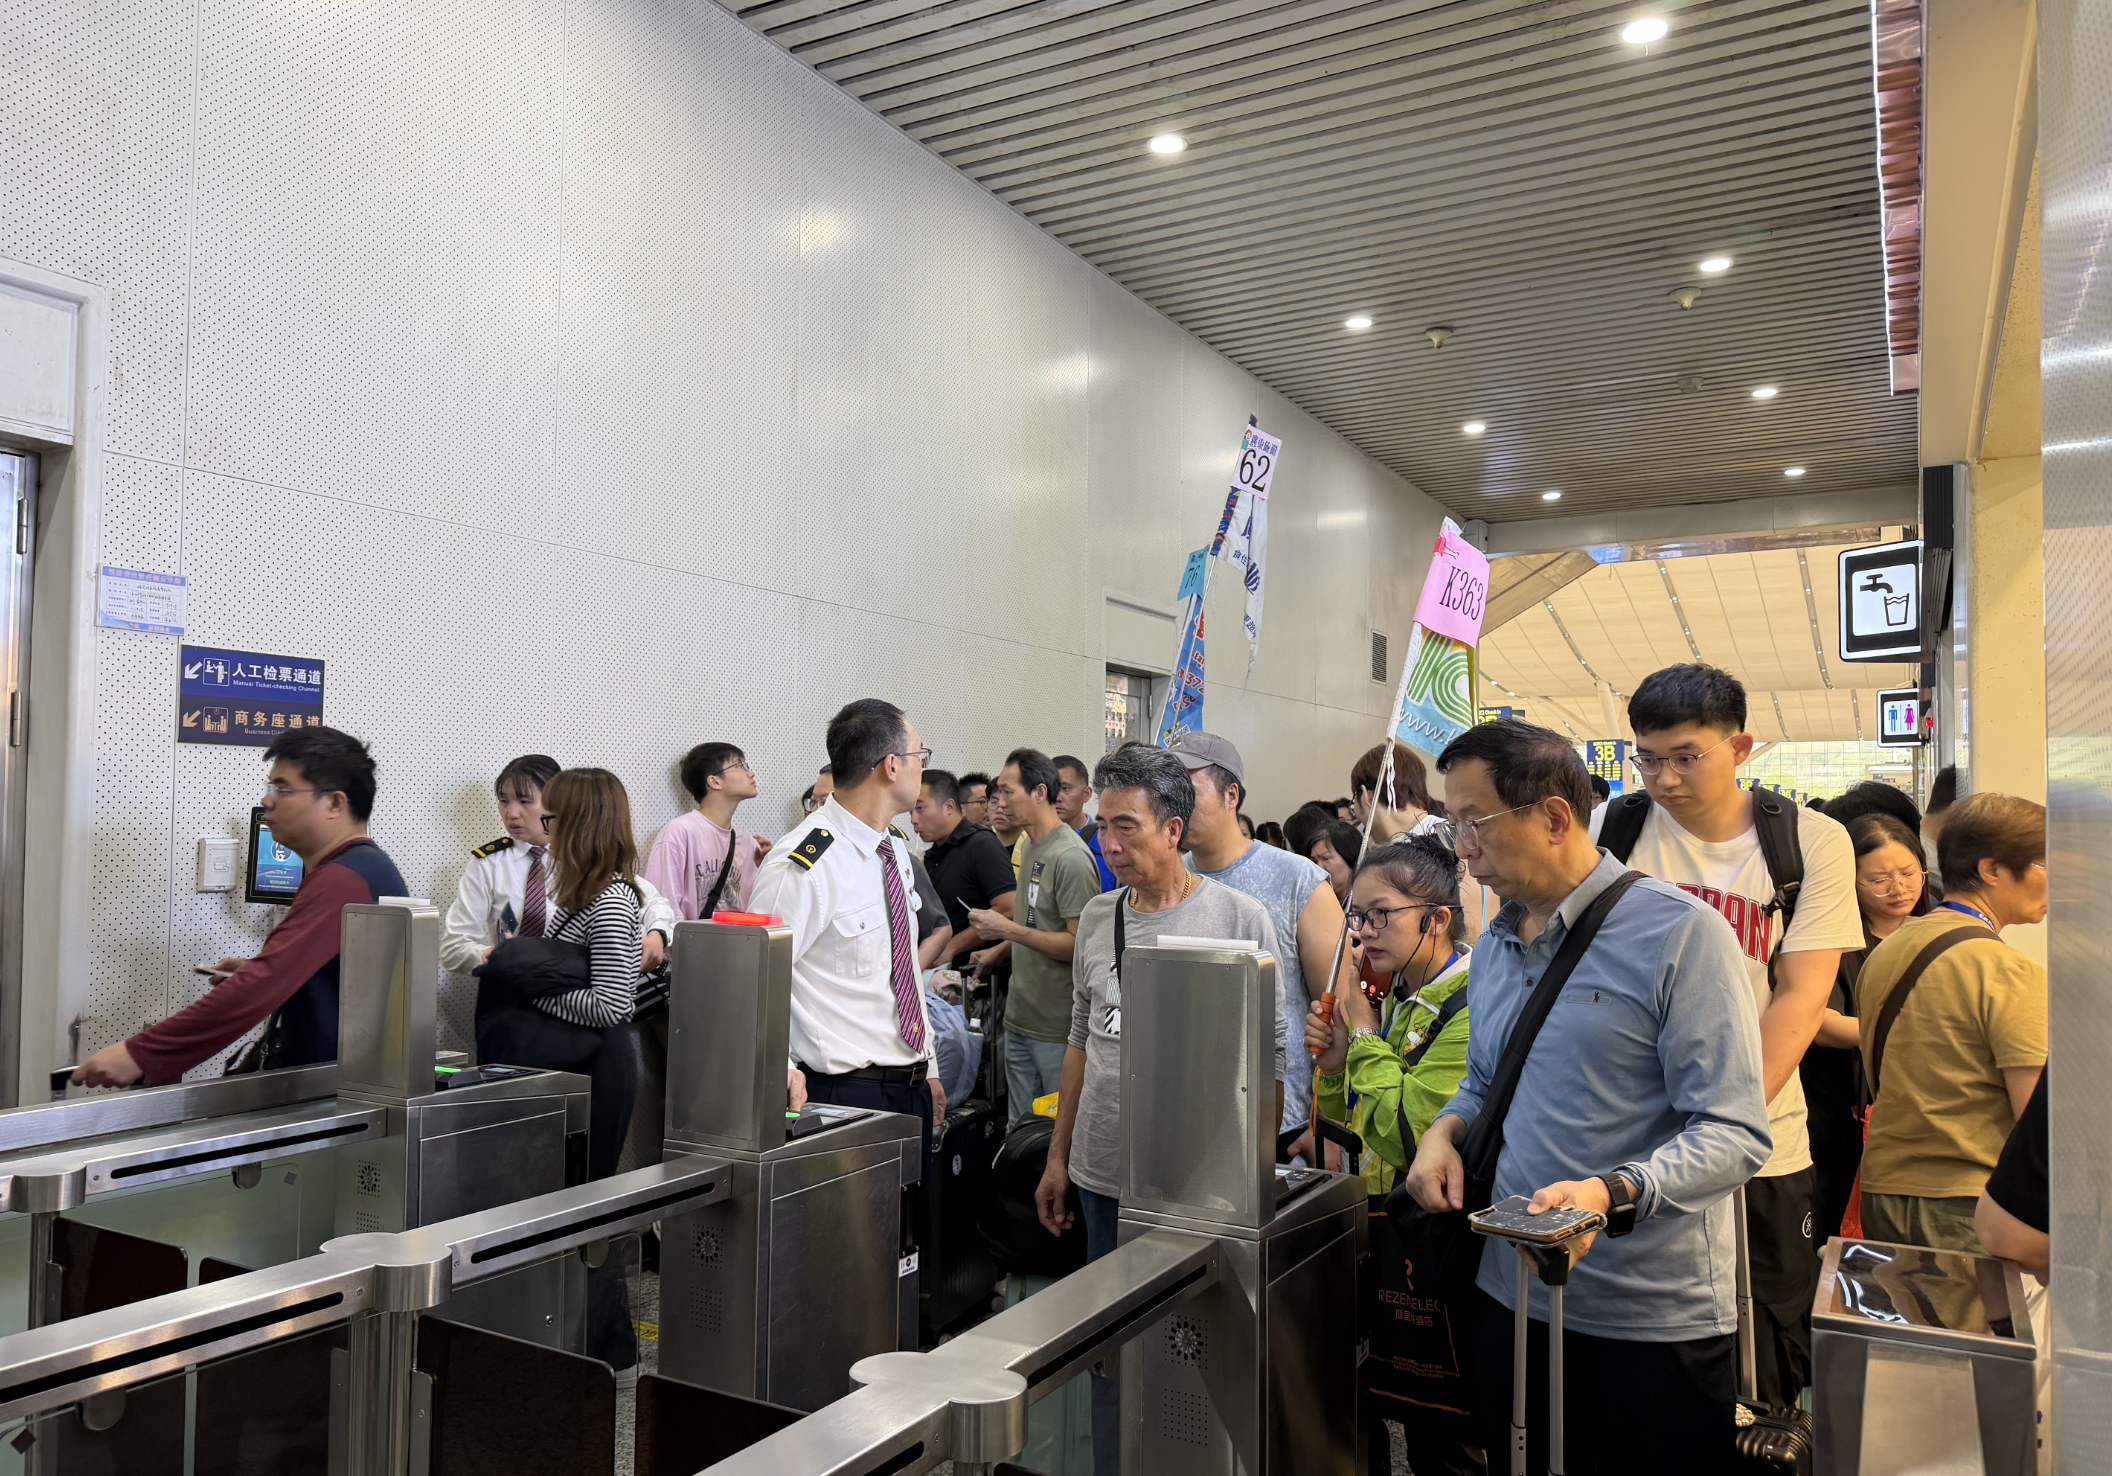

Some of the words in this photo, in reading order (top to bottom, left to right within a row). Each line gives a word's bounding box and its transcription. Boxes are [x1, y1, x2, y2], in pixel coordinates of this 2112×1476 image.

[1240, 449, 1270, 493] 62
[1184, 564, 1201, 590] 76
[1439, 565, 1484, 621] K363
[232, 662, 321, 685] 人工检票通道
[233, 679, 254, 687] Manual
[255, 681, 297, 692] Ticket-checking
[298, 685, 320, 693] Channel
[234, 709, 320, 729] 商务座通道
[244, 728, 271, 736] Business
[1595, 745, 1616, 761] 3B
